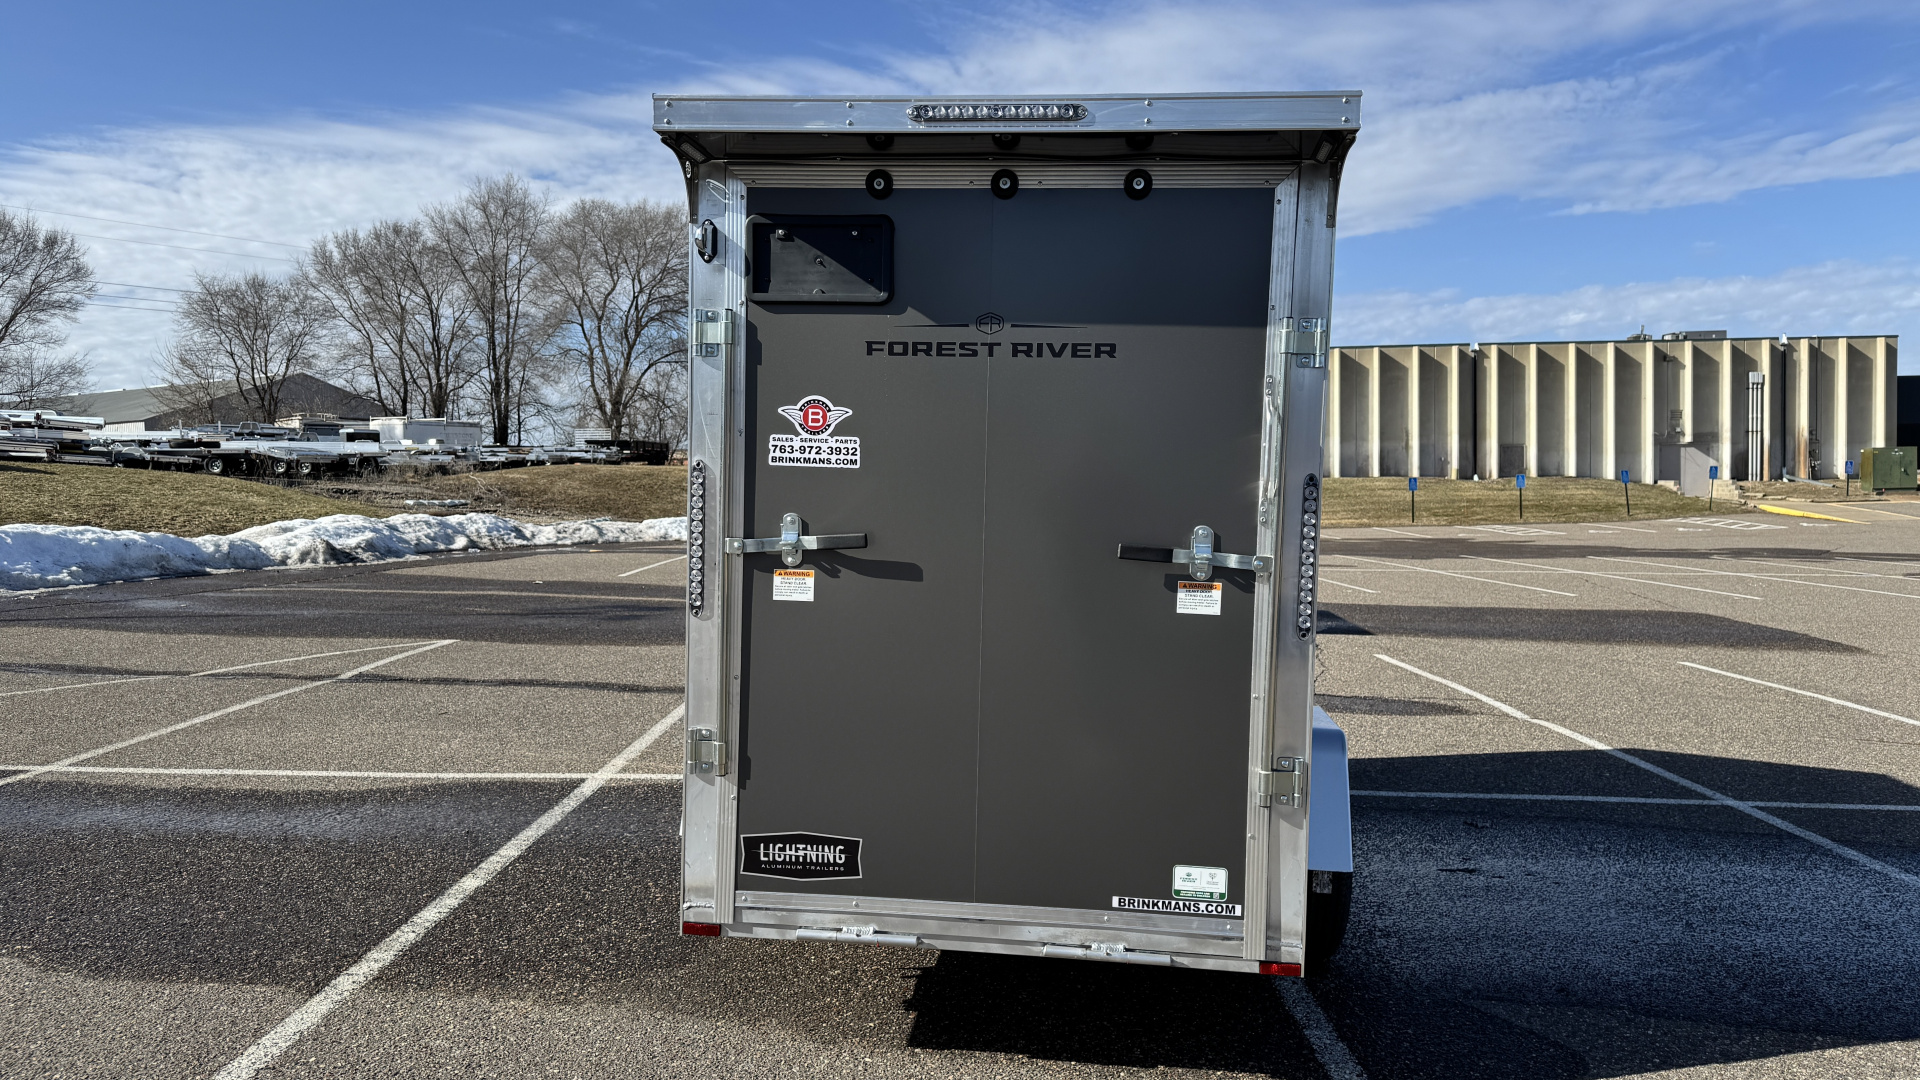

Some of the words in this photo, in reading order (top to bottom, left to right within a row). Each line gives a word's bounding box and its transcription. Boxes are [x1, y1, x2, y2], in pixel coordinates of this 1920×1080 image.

[864, 340, 1002, 357] FOREST
[1010, 342, 1117, 359] RIVER
[808, 408, 824, 426] B
[771, 444, 858, 457] 763-972-3932
[771, 456, 858, 466] BRINKMANS.COM
[760, 843, 846, 863] LIGHTNING
[1117, 897, 1236, 915] BRINKMANS.COM
